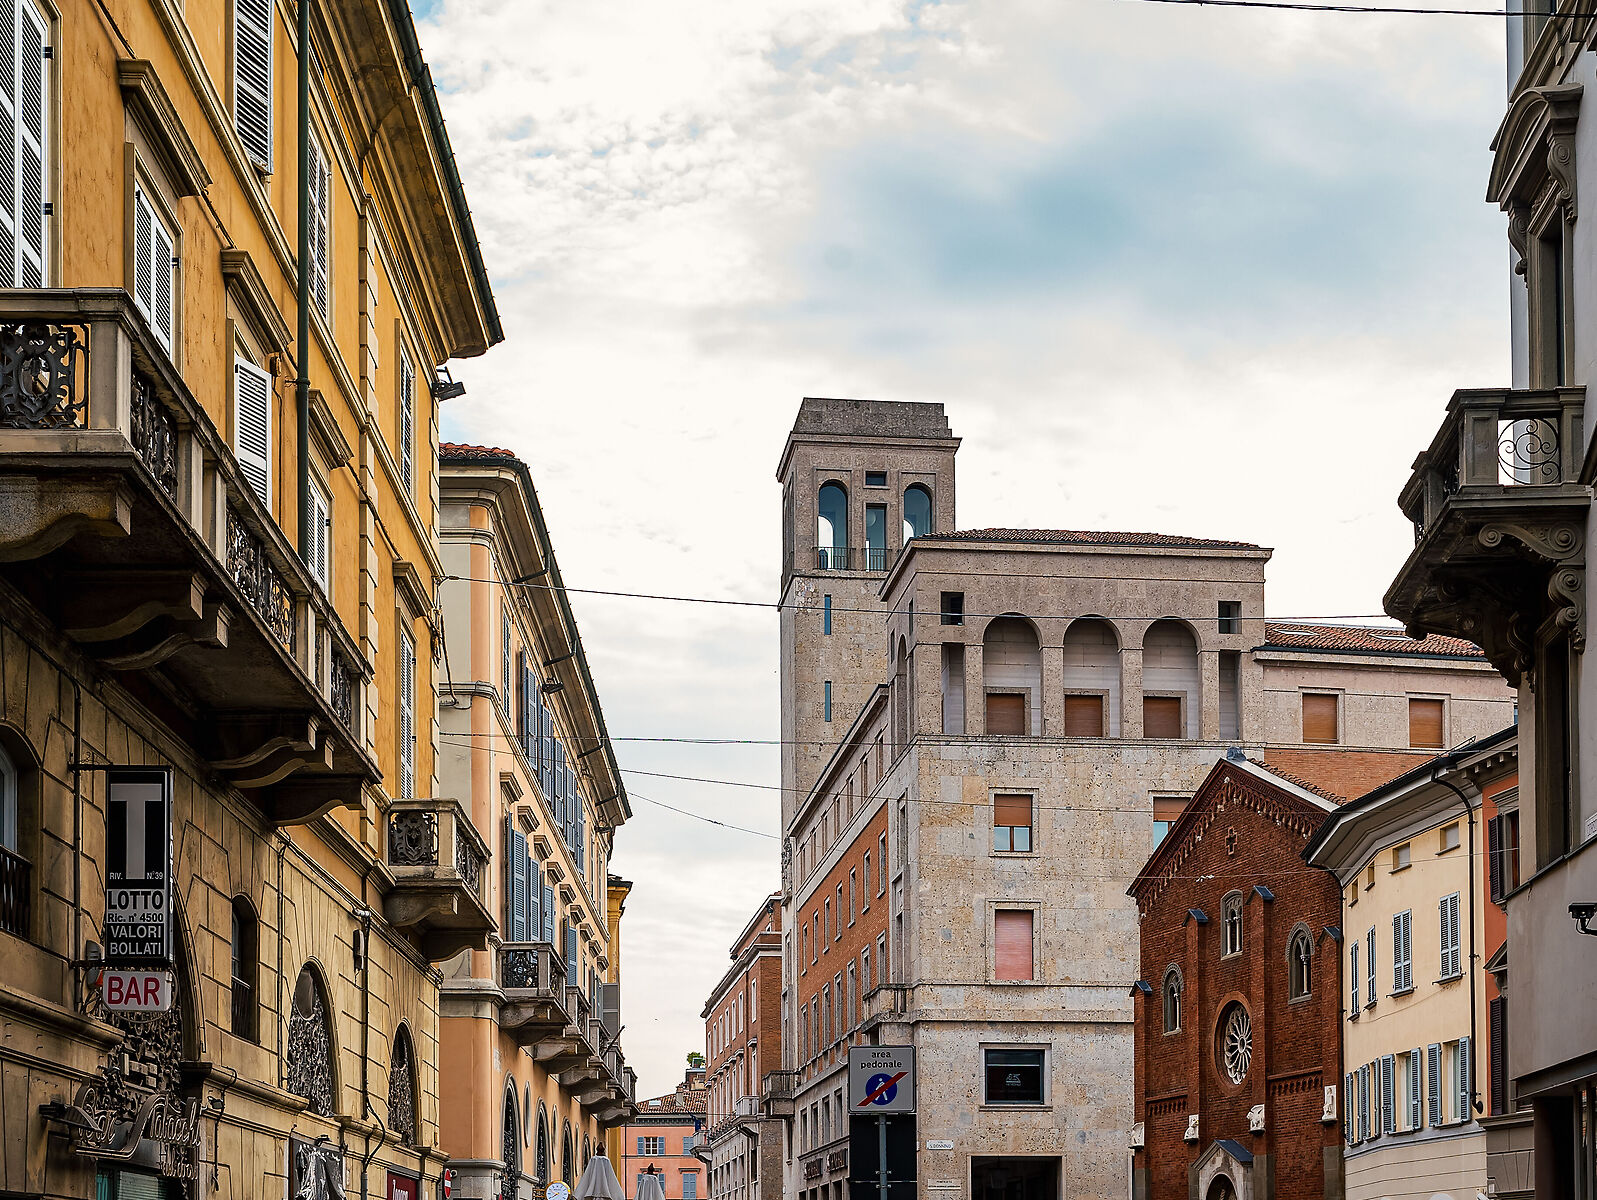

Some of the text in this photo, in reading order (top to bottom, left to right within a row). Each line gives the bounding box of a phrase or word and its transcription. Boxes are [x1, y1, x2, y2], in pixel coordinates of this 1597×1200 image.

[110, 783, 162, 879] T
[107, 890, 164, 910] LOTTO
[107, 912, 126, 922] Ric.
[139, 912, 164, 923] 4500
[111, 925, 162, 938] VALORI
[110, 942, 161, 955] BOLLATI
[107, 976, 160, 1006] BAR
[860, 1060, 902, 1069] pedonale
